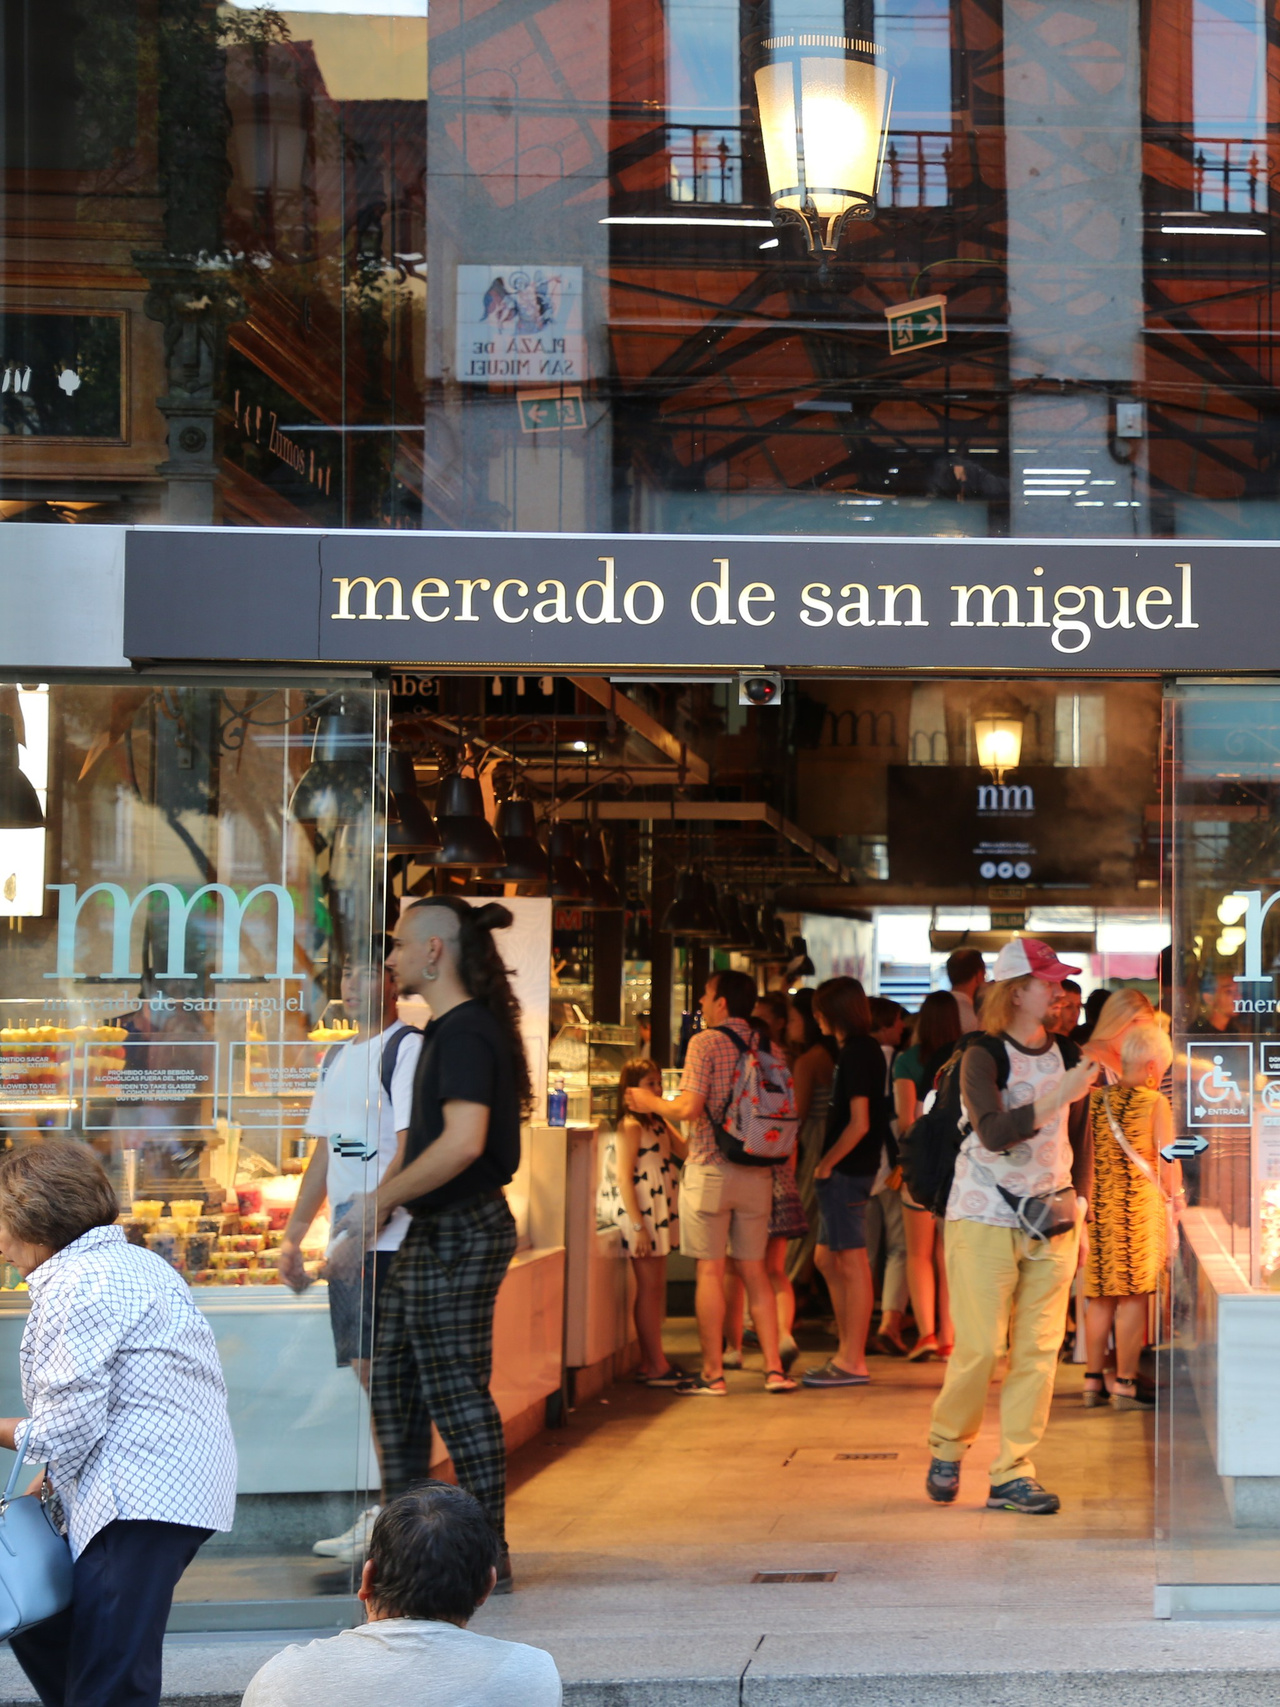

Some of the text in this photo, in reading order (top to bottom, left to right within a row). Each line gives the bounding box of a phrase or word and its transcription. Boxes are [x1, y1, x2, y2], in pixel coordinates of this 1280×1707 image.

[269, 410, 305, 475] Zumos
[331, 556, 1200, 654] mercado de san miguel
[42, 990, 305, 1018] mercado de san miguel
[1207, 1108, 1246, 1116] ENTRADA
